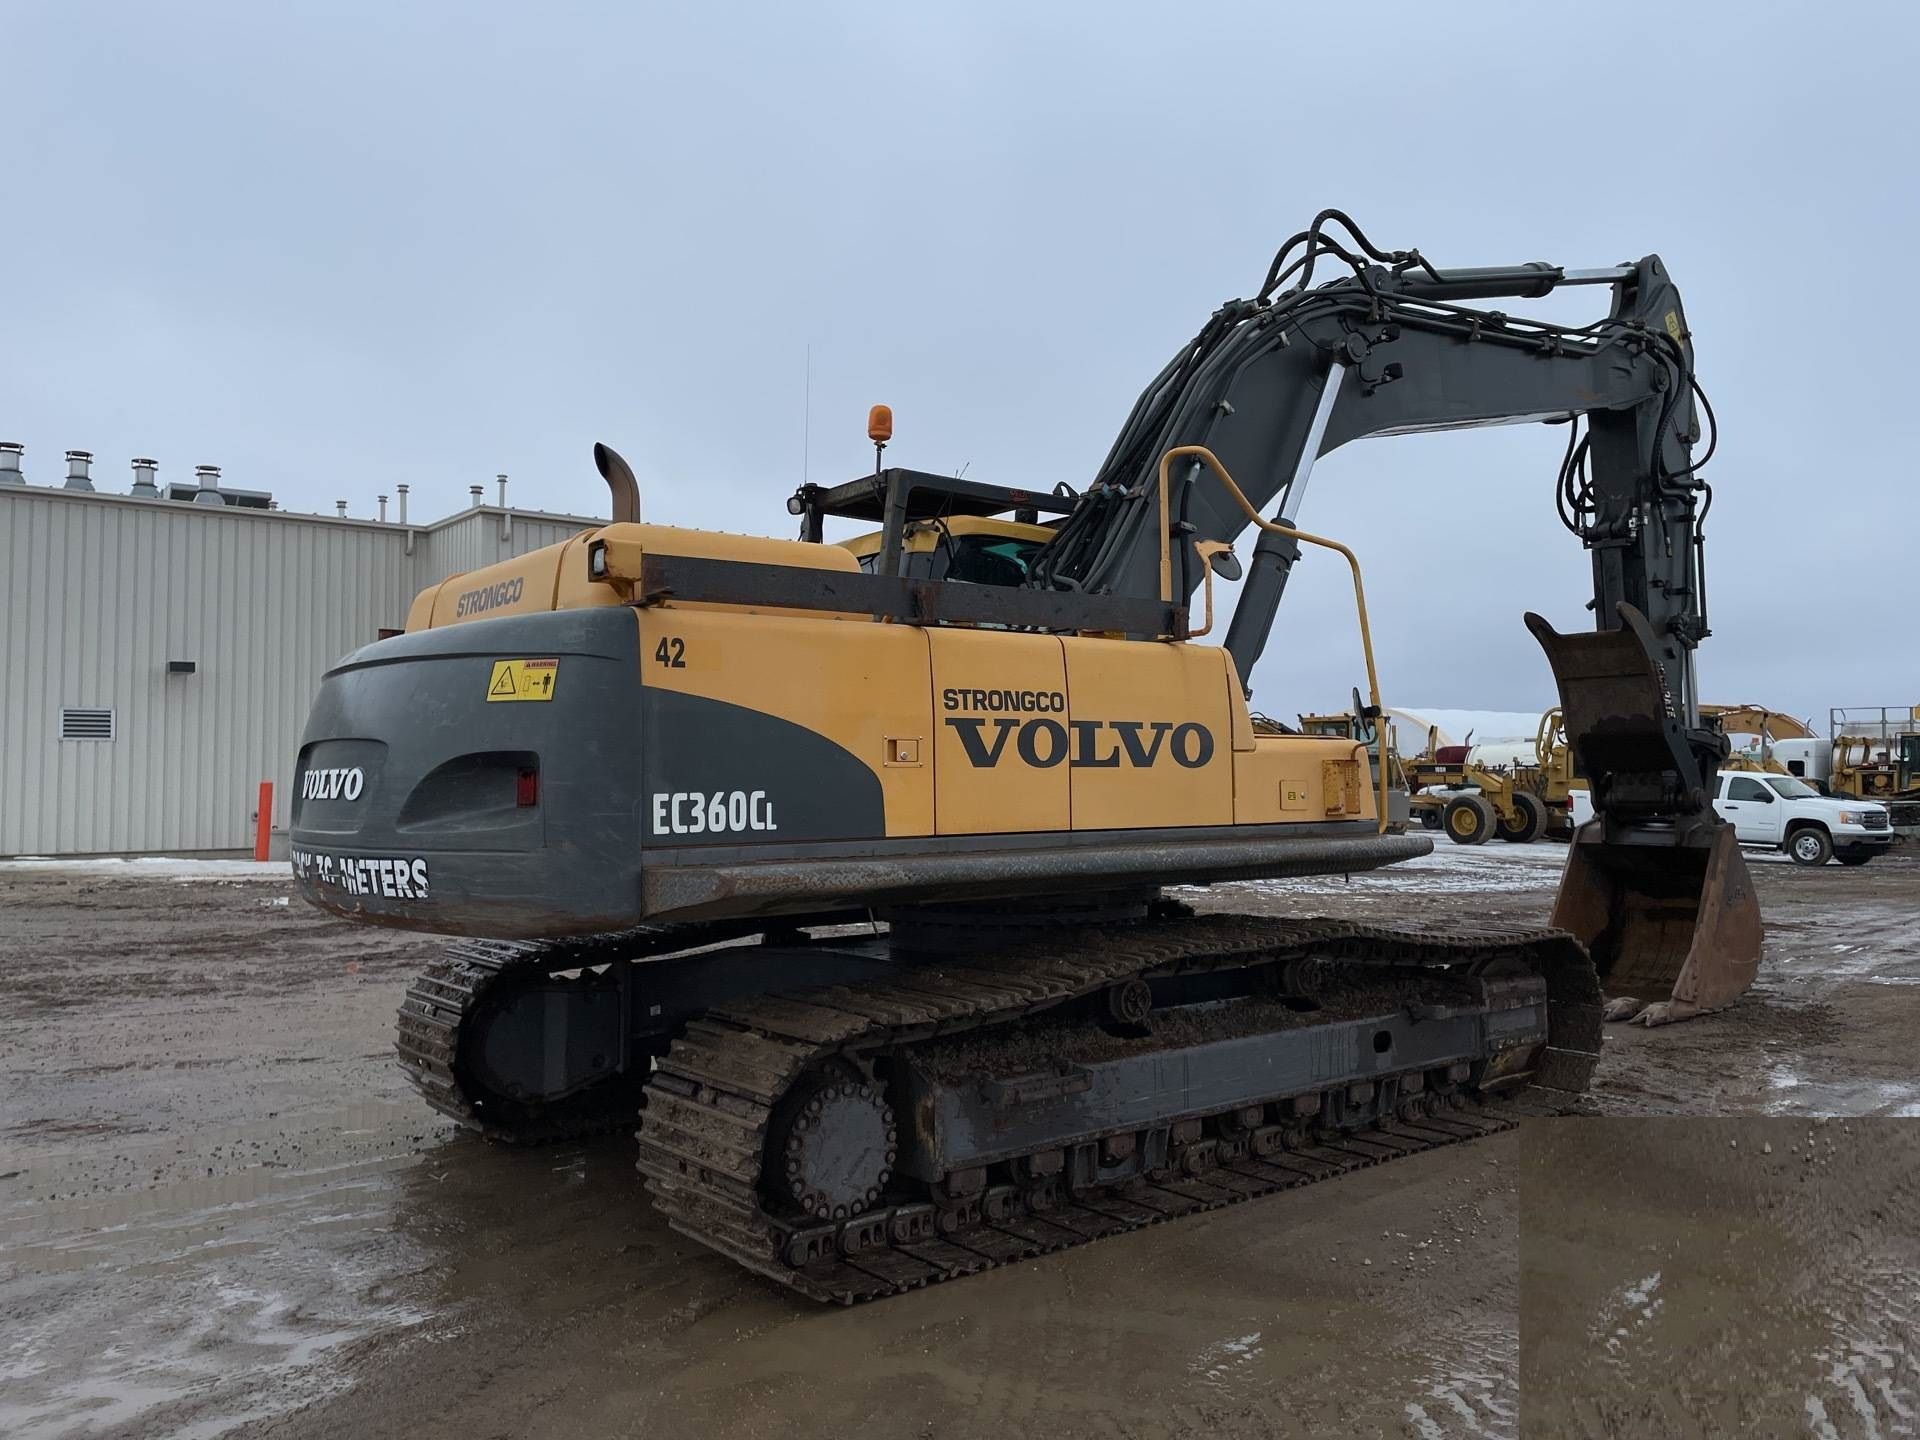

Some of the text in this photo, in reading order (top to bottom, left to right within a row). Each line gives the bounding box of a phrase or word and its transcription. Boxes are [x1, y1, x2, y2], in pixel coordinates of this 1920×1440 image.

[457, 577, 524, 618] STRONGCO
[655, 637, 686, 668] 42
[943, 688, 1065, 713] STRONGCO
[945, 717, 1215, 769] VOLVO
[302, 767, 364, 801] VOLVO
[339, 857, 430, 899] METERS
